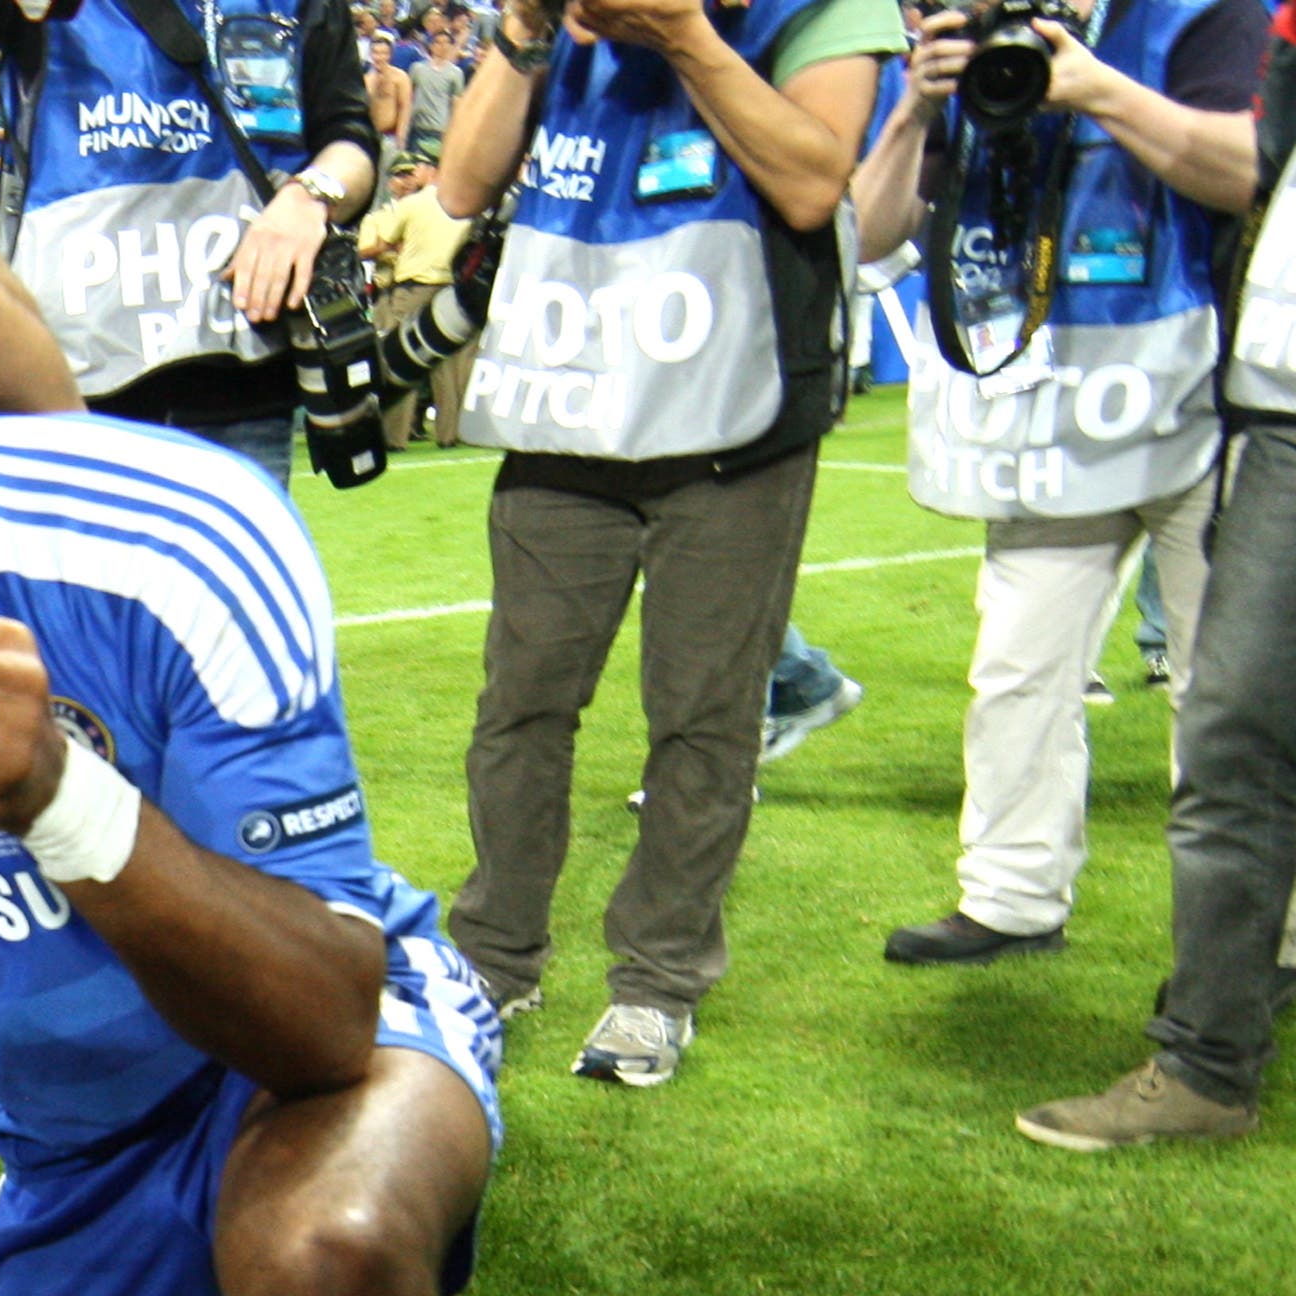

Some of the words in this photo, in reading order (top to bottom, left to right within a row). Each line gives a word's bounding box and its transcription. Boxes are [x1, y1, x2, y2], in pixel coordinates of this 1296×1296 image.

[78, 92, 212, 137] MUNICH
[78, 127, 154, 157] FINAL
[61, 203, 261, 316] PHO
[479, 267, 714, 368] HOTO
[463, 357, 629, 431] PITCH
